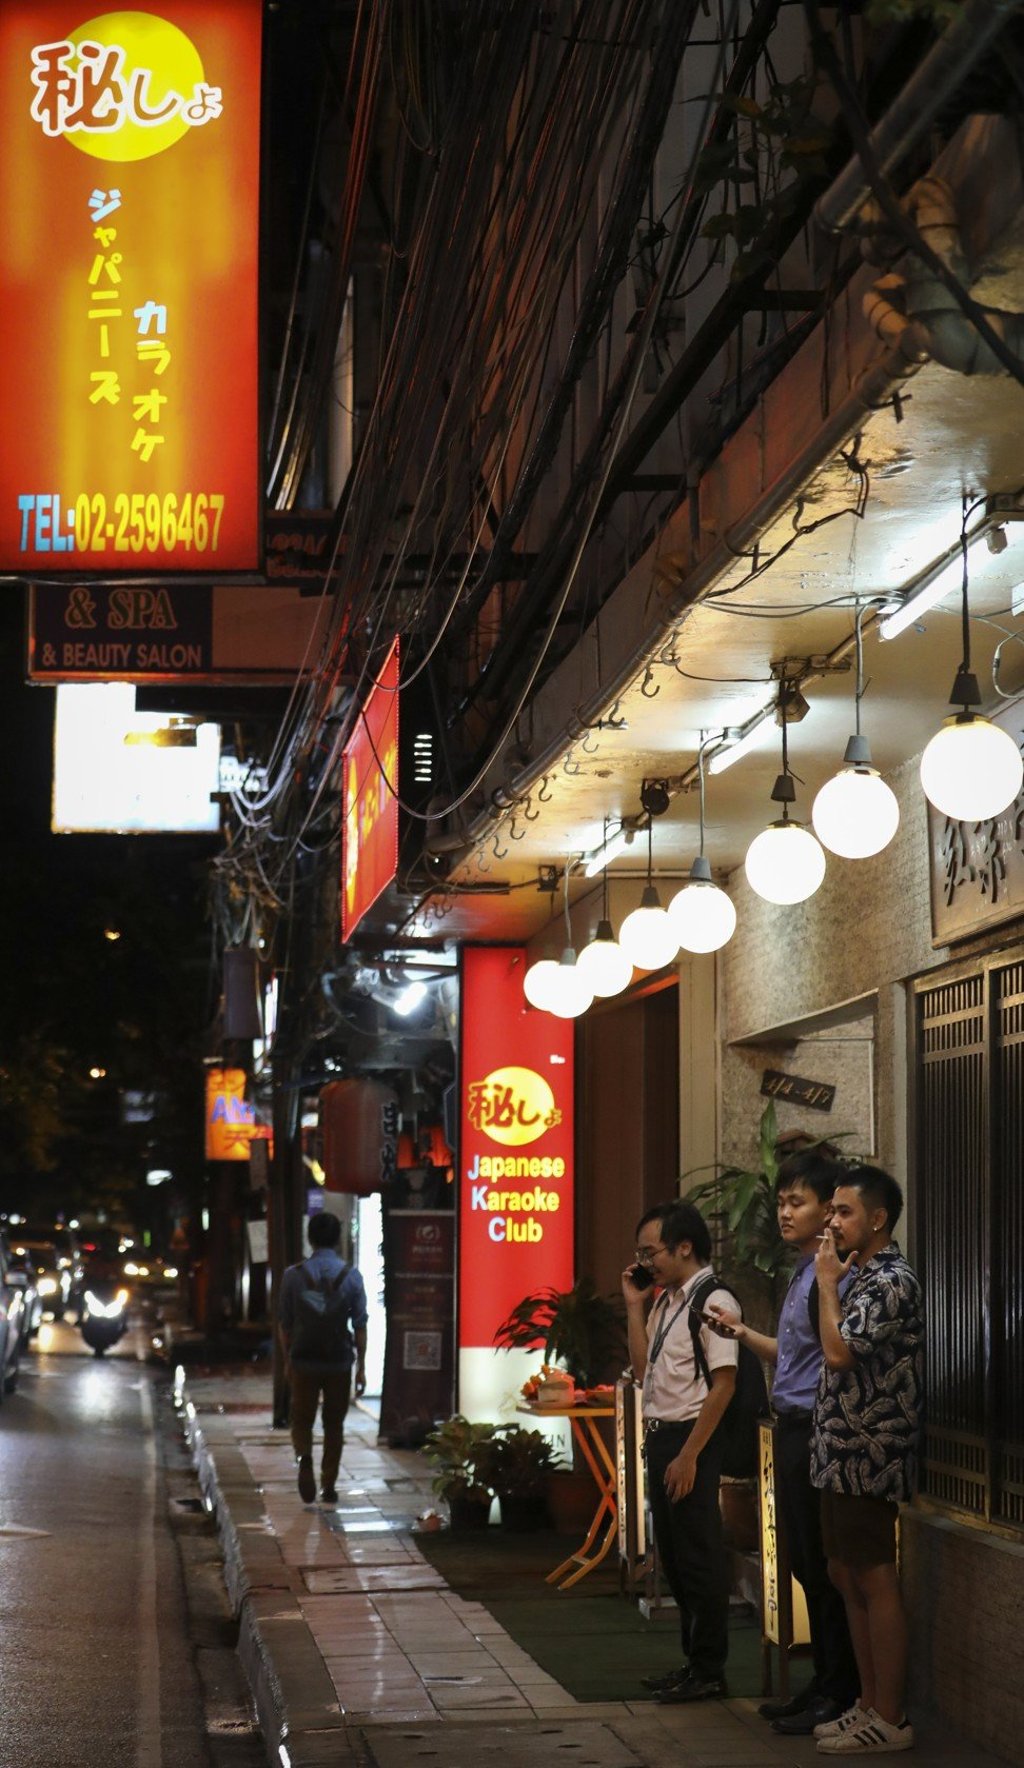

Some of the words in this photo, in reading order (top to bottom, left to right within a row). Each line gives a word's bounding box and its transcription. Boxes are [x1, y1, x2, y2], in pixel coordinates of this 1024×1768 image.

[131, 301, 171, 462] カラオケ
[65, 588, 97, 628] &
[107, 589, 178, 629] SPA
[42, 644, 57, 666] &
[63, 644, 132, 667] BEAUTY
[136, 645, 201, 667] SALON
[467, 1154, 565, 1182] Japanese
[471, 1185, 560, 1212] Karaoke
[488, 1216, 543, 1243] Club
